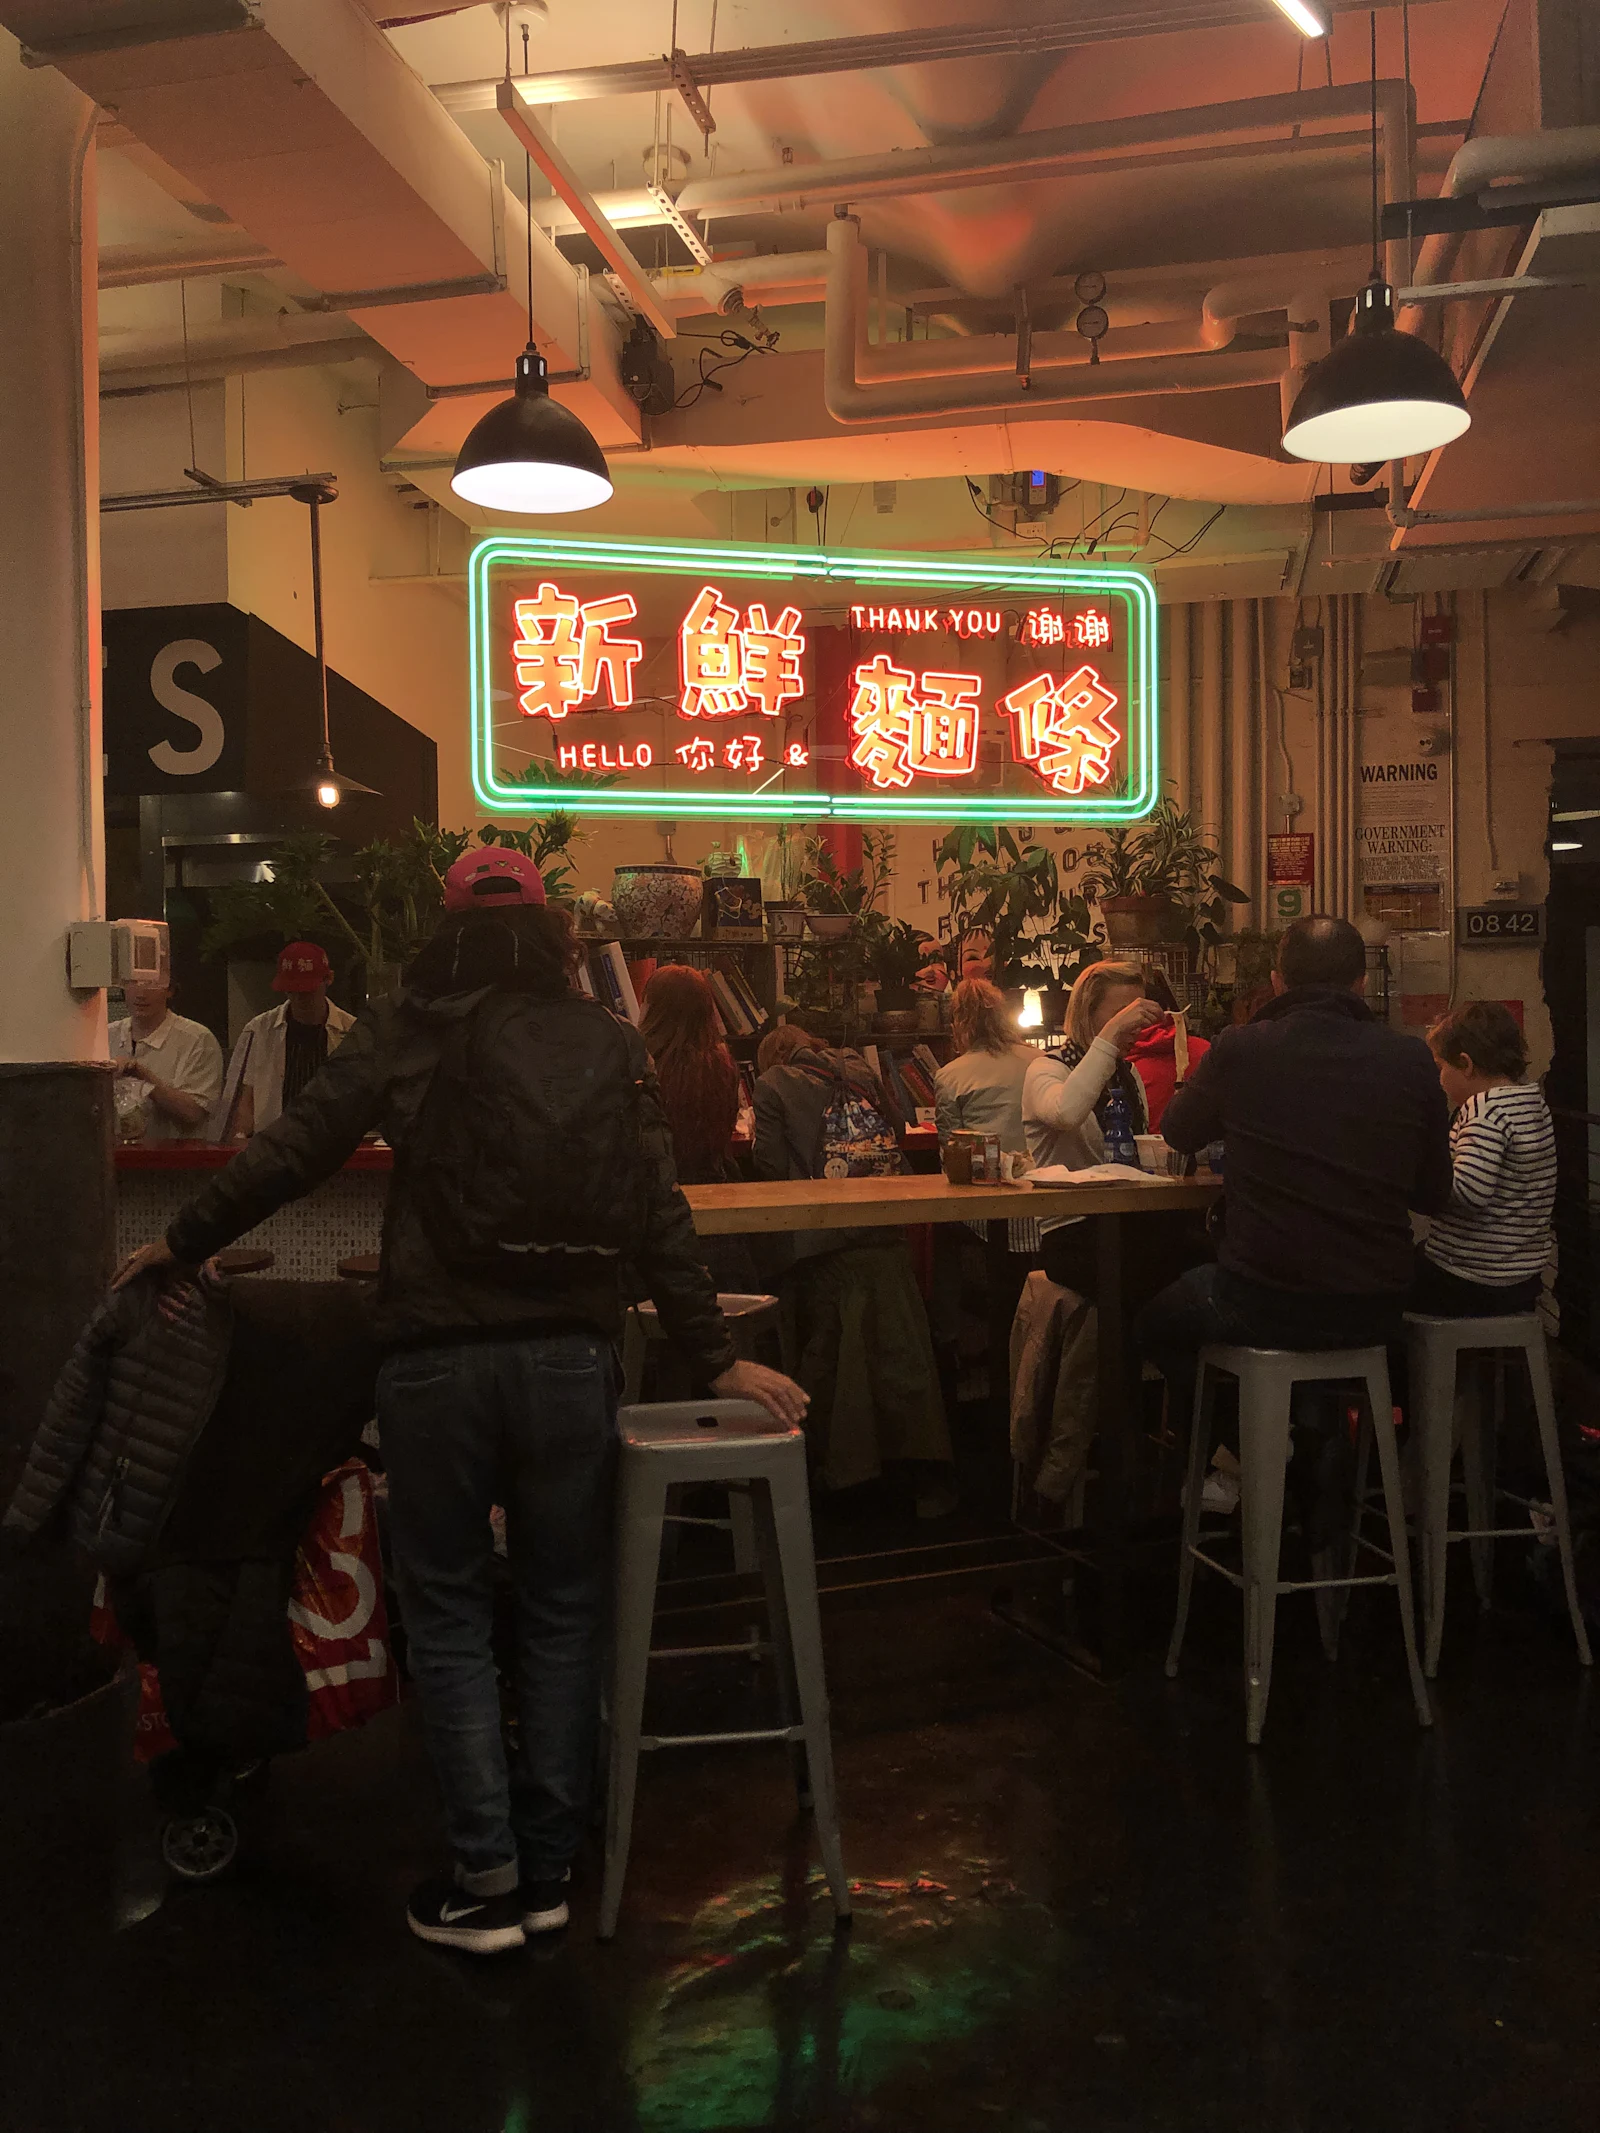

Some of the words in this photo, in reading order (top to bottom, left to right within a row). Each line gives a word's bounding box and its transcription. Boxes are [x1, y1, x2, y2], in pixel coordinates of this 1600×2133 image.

[851, 606, 939, 632] THANK
[949, 609, 1001, 634] YOU
[559, 743, 653, 769] HELLO
[674, 735, 765, 772] 你好
[788, 743, 810, 766] &
[1360, 763, 1438, 783] WARNING
[1355, 824, 1446, 841] GOVERNMENT
[1367, 839, 1433, 855] WARNING:
